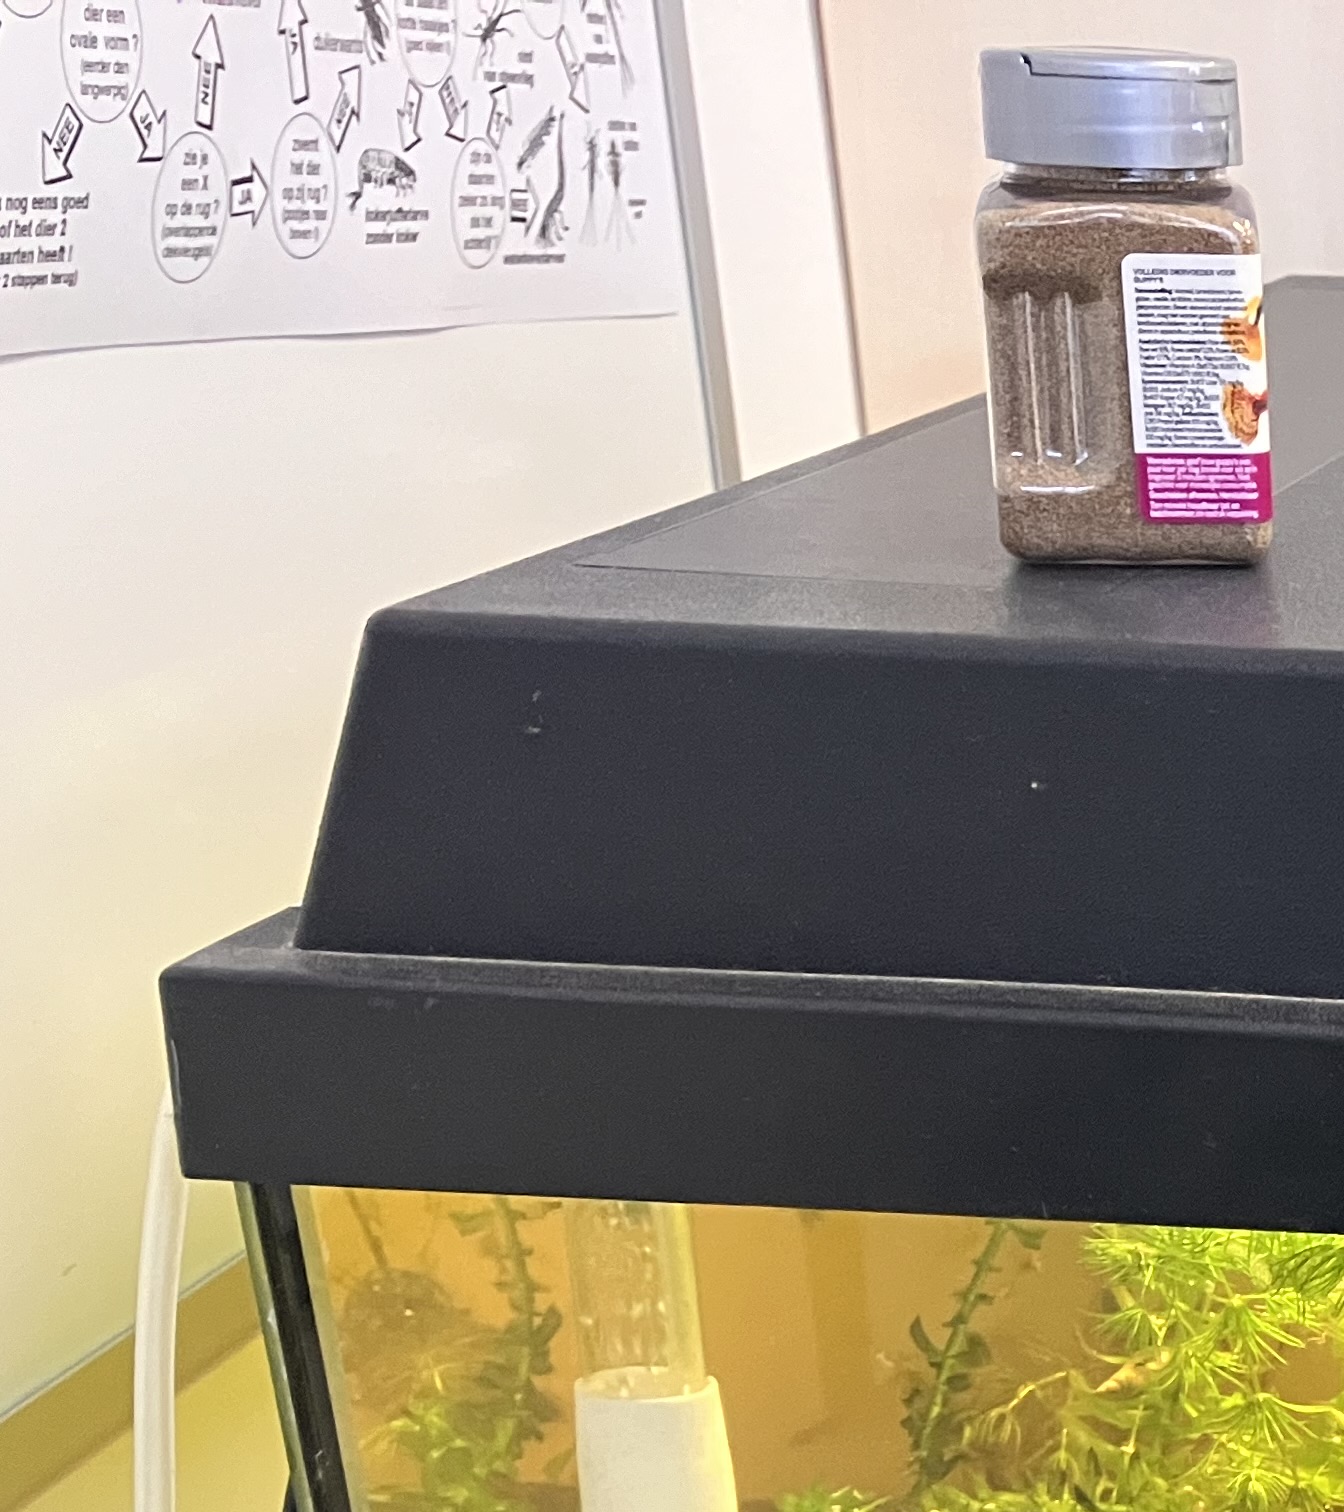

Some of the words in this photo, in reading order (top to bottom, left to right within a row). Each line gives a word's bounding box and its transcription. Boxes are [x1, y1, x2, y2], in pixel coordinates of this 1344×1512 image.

[53, 116, 75, 160] NEE
[5, 197, 28, 214] nog
[32, 196, 58, 210] eens
[61, 192, 90, 214] goed
[14, 219, 32, 237] het
[35, 218, 57, 237] dier
[60, 218, 67, 236] 2
[37, 245, 65, 263] heeft
